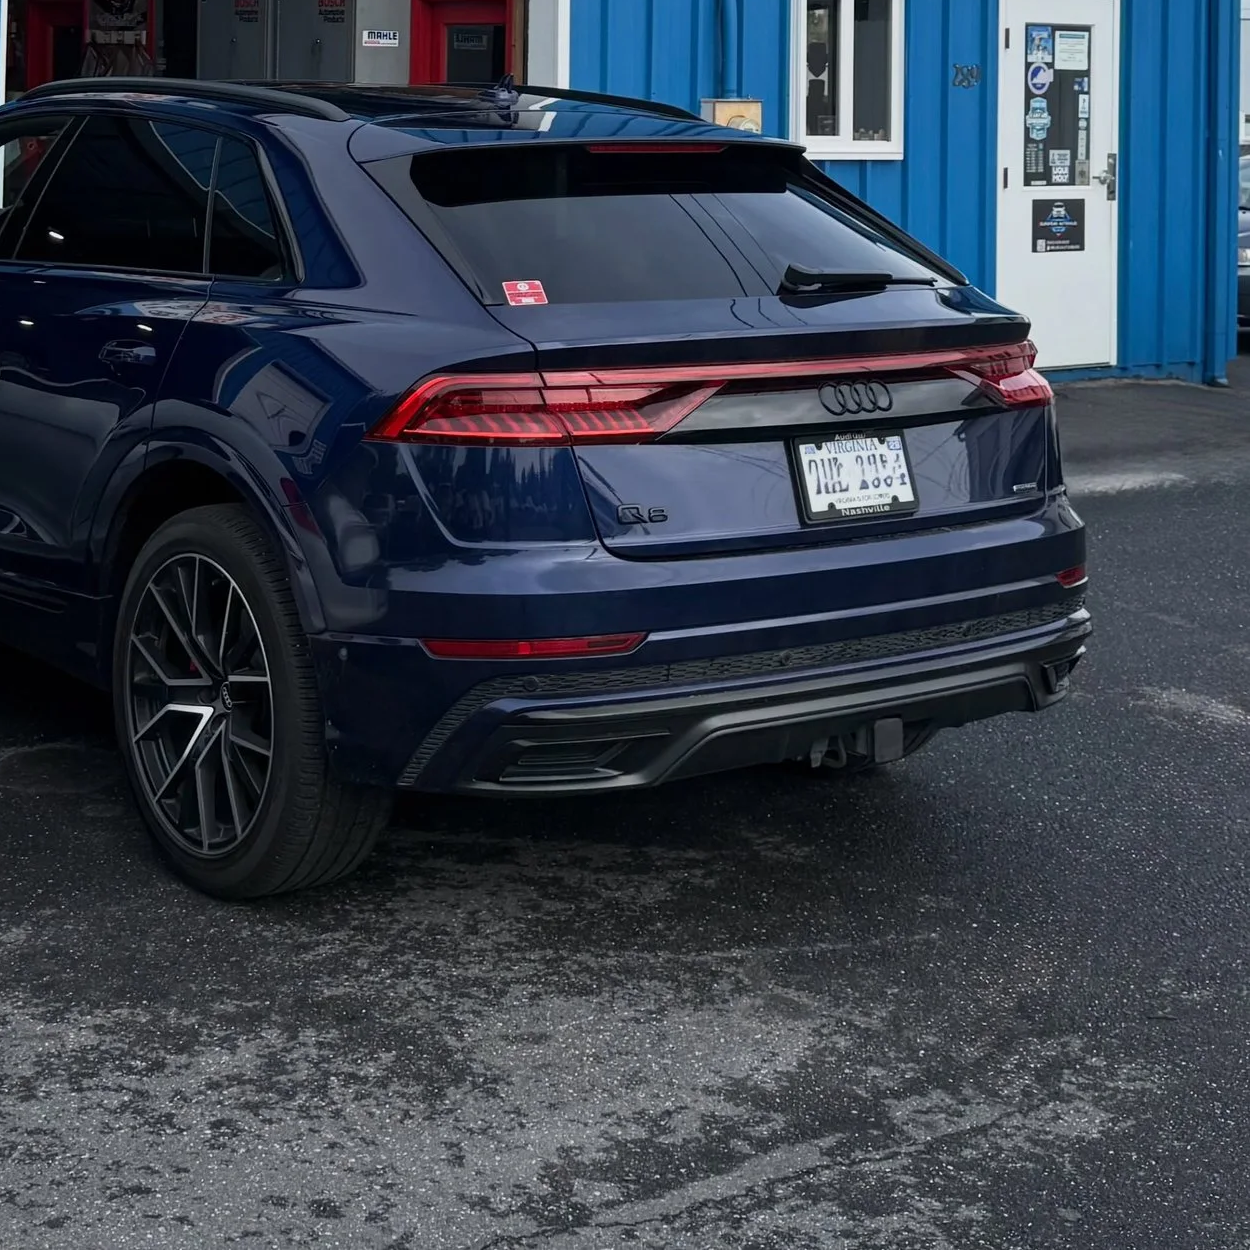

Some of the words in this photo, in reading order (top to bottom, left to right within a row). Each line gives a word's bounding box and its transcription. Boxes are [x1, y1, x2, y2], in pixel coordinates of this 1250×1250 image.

[367, 31, 398, 40] MAHLE
[825, 438, 878, 454] VIRGINIA
[841, 504, 890, 516] Nashville
